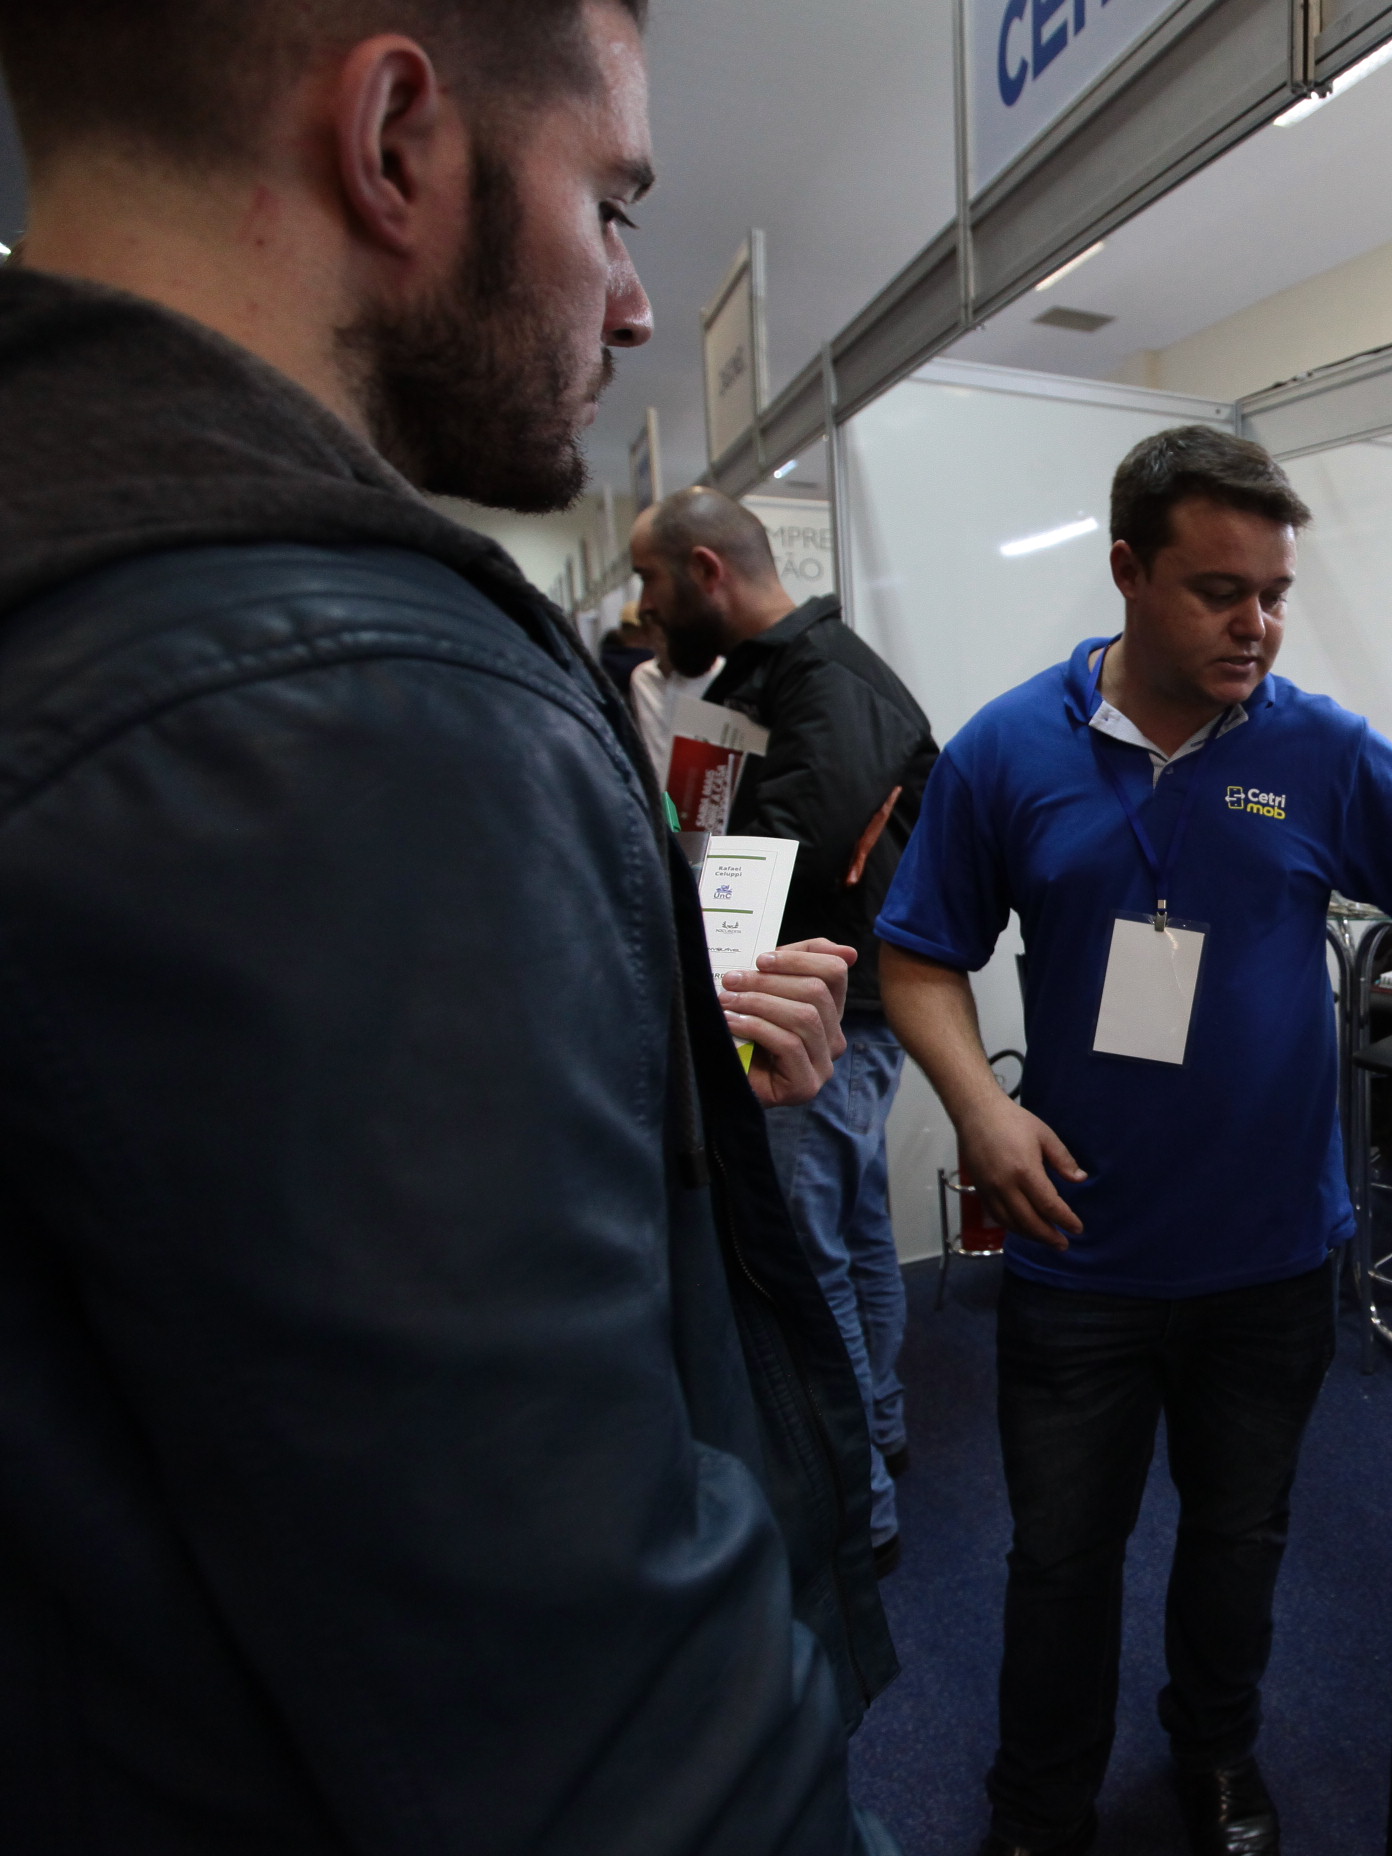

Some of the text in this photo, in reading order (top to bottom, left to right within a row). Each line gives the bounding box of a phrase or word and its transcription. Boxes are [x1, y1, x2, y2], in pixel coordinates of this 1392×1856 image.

[1247, 788, 1286, 808] Cetri
[1246, 803, 1286, 819] mob
[713, 892, 732, 900] UnC
